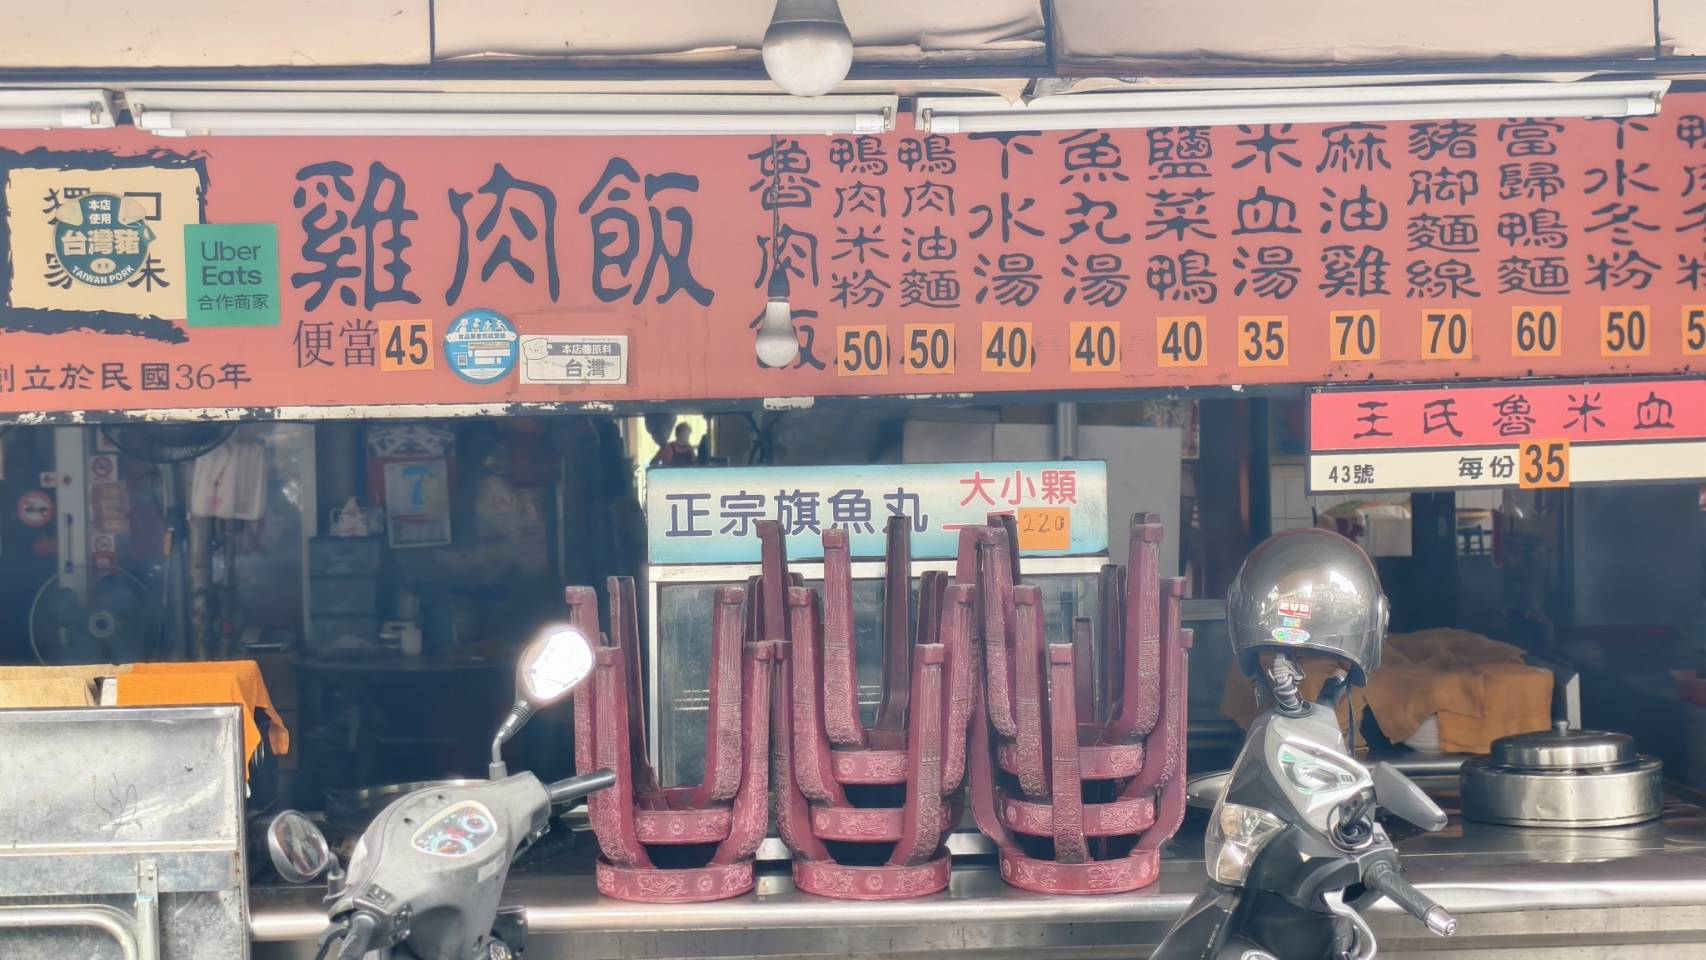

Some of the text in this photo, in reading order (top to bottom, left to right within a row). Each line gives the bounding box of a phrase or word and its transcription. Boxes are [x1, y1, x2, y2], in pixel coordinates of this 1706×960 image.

[88, 200, 112, 211] 本店
[89, 214, 112, 224] 使用
[828, 134, 892, 309] 鴨肉米粉
[897, 134, 961, 309] 鴨肉油麵
[967, 130, 1046, 308] 下水湯
[1058, 129, 1132, 308] 魚丸湯
[1145, 125, 1218, 305] 鹽菜鴨
[1231, 123, 1302, 300] 米血湯
[1316, 121, 1392, 298] 麻油雞
[1496, 117, 1572, 296] 當歸鴨麵
[1583, 114, 1663, 291] 下水冬粉
[61, 229, 141, 256] 台灣豬
[201, 241, 261, 262] Uber
[290, 155, 716, 312] 雞肉飯
[71, 264, 136, 285] TAIWAN PORK
[202, 266, 263, 286] Eats
[198, 294, 269, 311] 合作商家
[293, 319, 379, 368] 便當
[384, 324, 429, 366] 45
[910, 330, 949, 369] 50
[986, 327, 1027, 368] 40
[1075, 326, 1116, 367] 40
[1161, 321, 1203, 361] 40
[1244, 321, 1285, 361] 35
[1335, 314, 1376, 355] 70
[1426, 314, 1467, 354] 70
[1516, 311, 1557, 351] 60
[1606, 310, 1646, 350] 50
[565, 358, 606, 378] 台灣
[843, 331, 883, 371] 50
[1353, 390, 1676, 440] 王氏魯米血
[1328, 455, 1516, 485] 43號 每份
[1523, 442, 1565, 484] 35
[959, 469, 1078, 507] 大小顆
[664, 486, 930, 540] 正宗旗魚丸
[1022, 511, 1066, 533] 220
